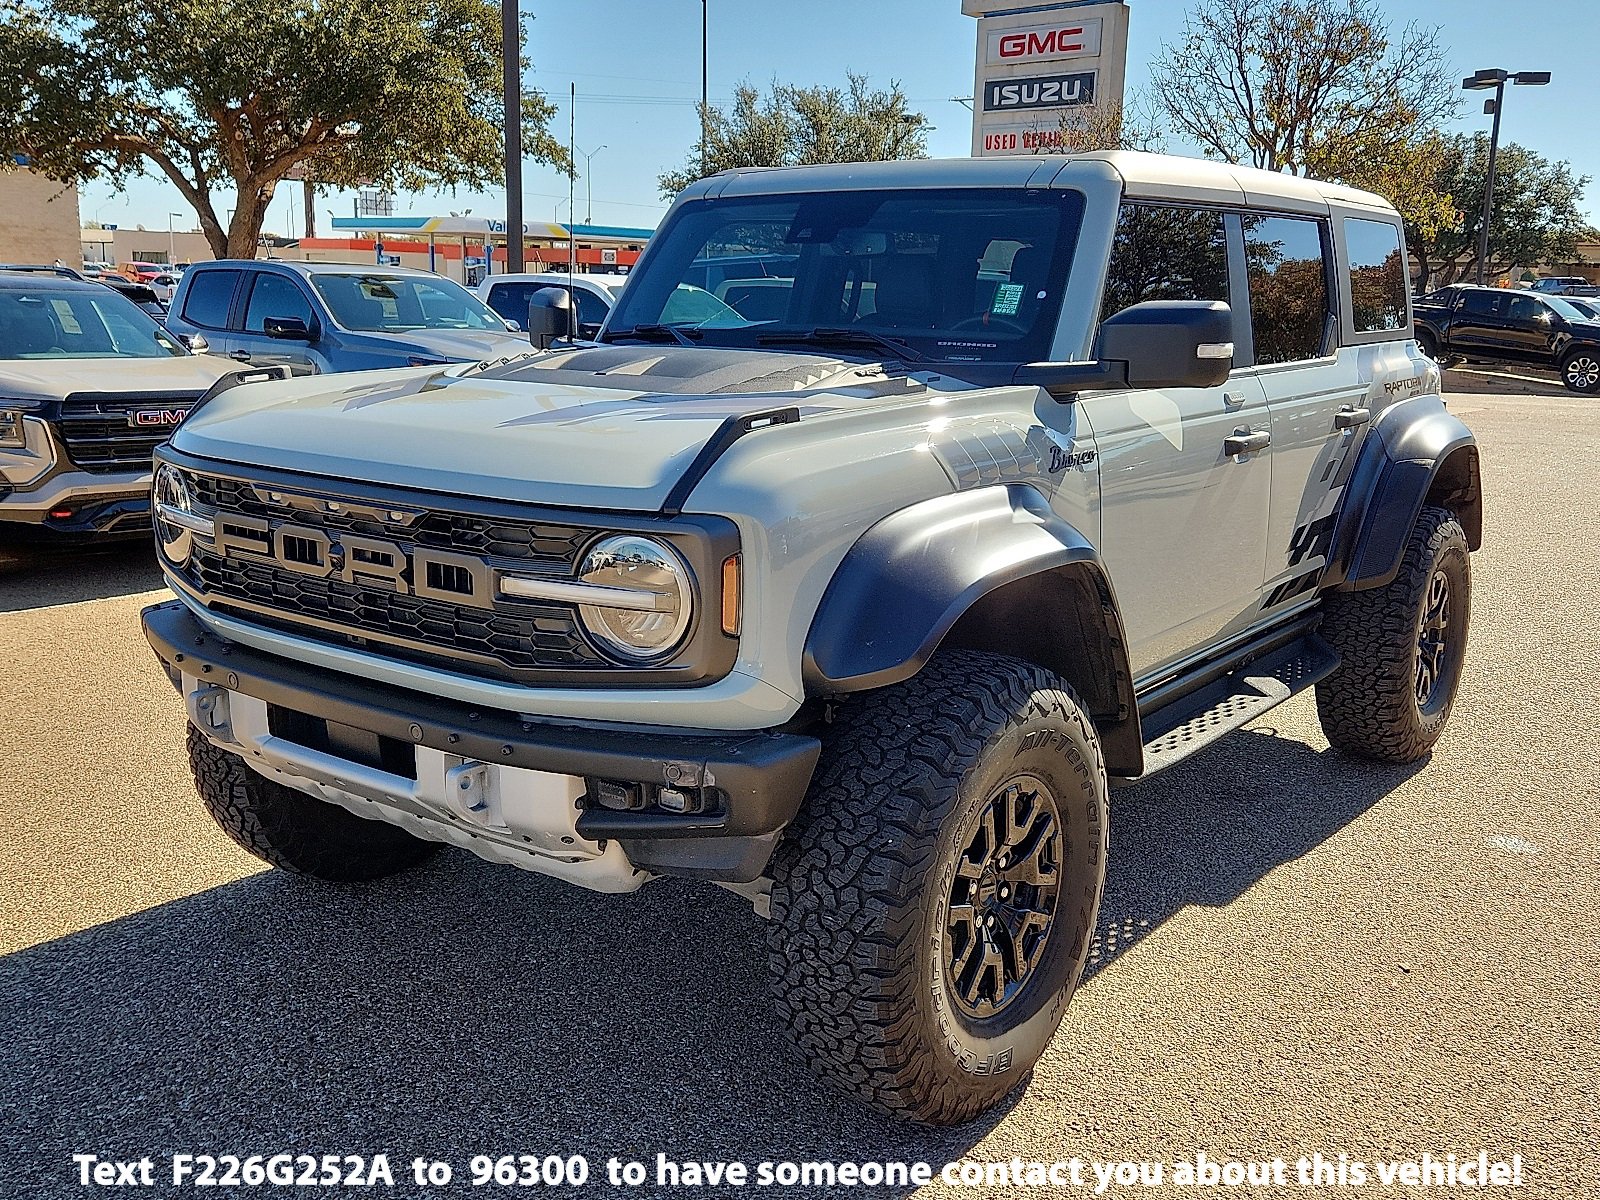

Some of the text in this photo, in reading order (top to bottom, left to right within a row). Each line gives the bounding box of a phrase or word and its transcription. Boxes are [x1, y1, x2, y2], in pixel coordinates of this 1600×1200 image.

[999, 27, 1083, 58] GMC
[992, 79, 1081, 106] ISUZU
[985, 133, 1016, 151] USED
[487, 219, 529, 234] Valo
[136, 409, 190, 425] GM
[1048, 445, 1098, 474] Bronco
[214, 510, 496, 611] FORD
